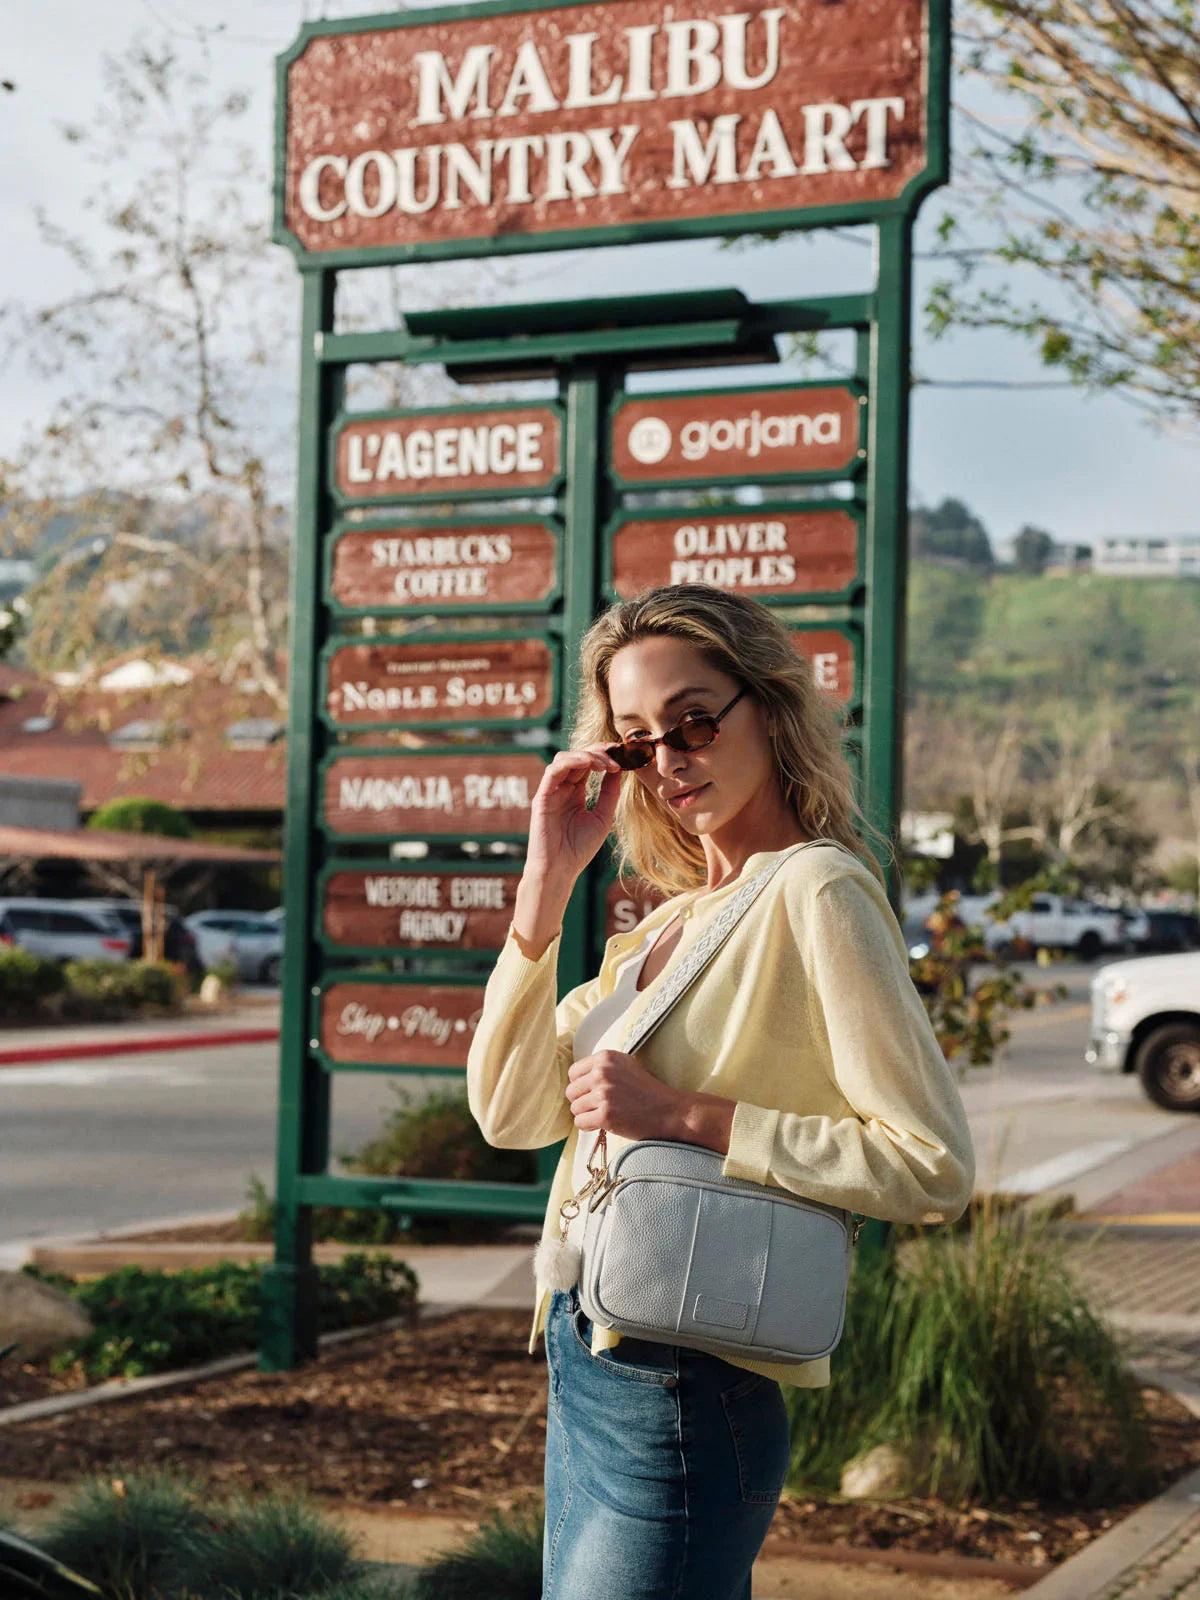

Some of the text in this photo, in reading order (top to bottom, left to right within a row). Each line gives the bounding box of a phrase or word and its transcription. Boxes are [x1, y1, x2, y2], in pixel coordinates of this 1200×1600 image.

[414, 9, 786, 126] MALIBU
[299, 96, 906, 222] COUNTRY MART
[347, 422, 545, 483] L'AGENCE
[680, 410, 841, 460] gorjana
[371, 534, 513, 567] STARBUCKS
[673, 521, 788, 558] OLIVER
[394, 567, 488, 599] COFFEE
[669, 555, 797, 587] PEOPLES
